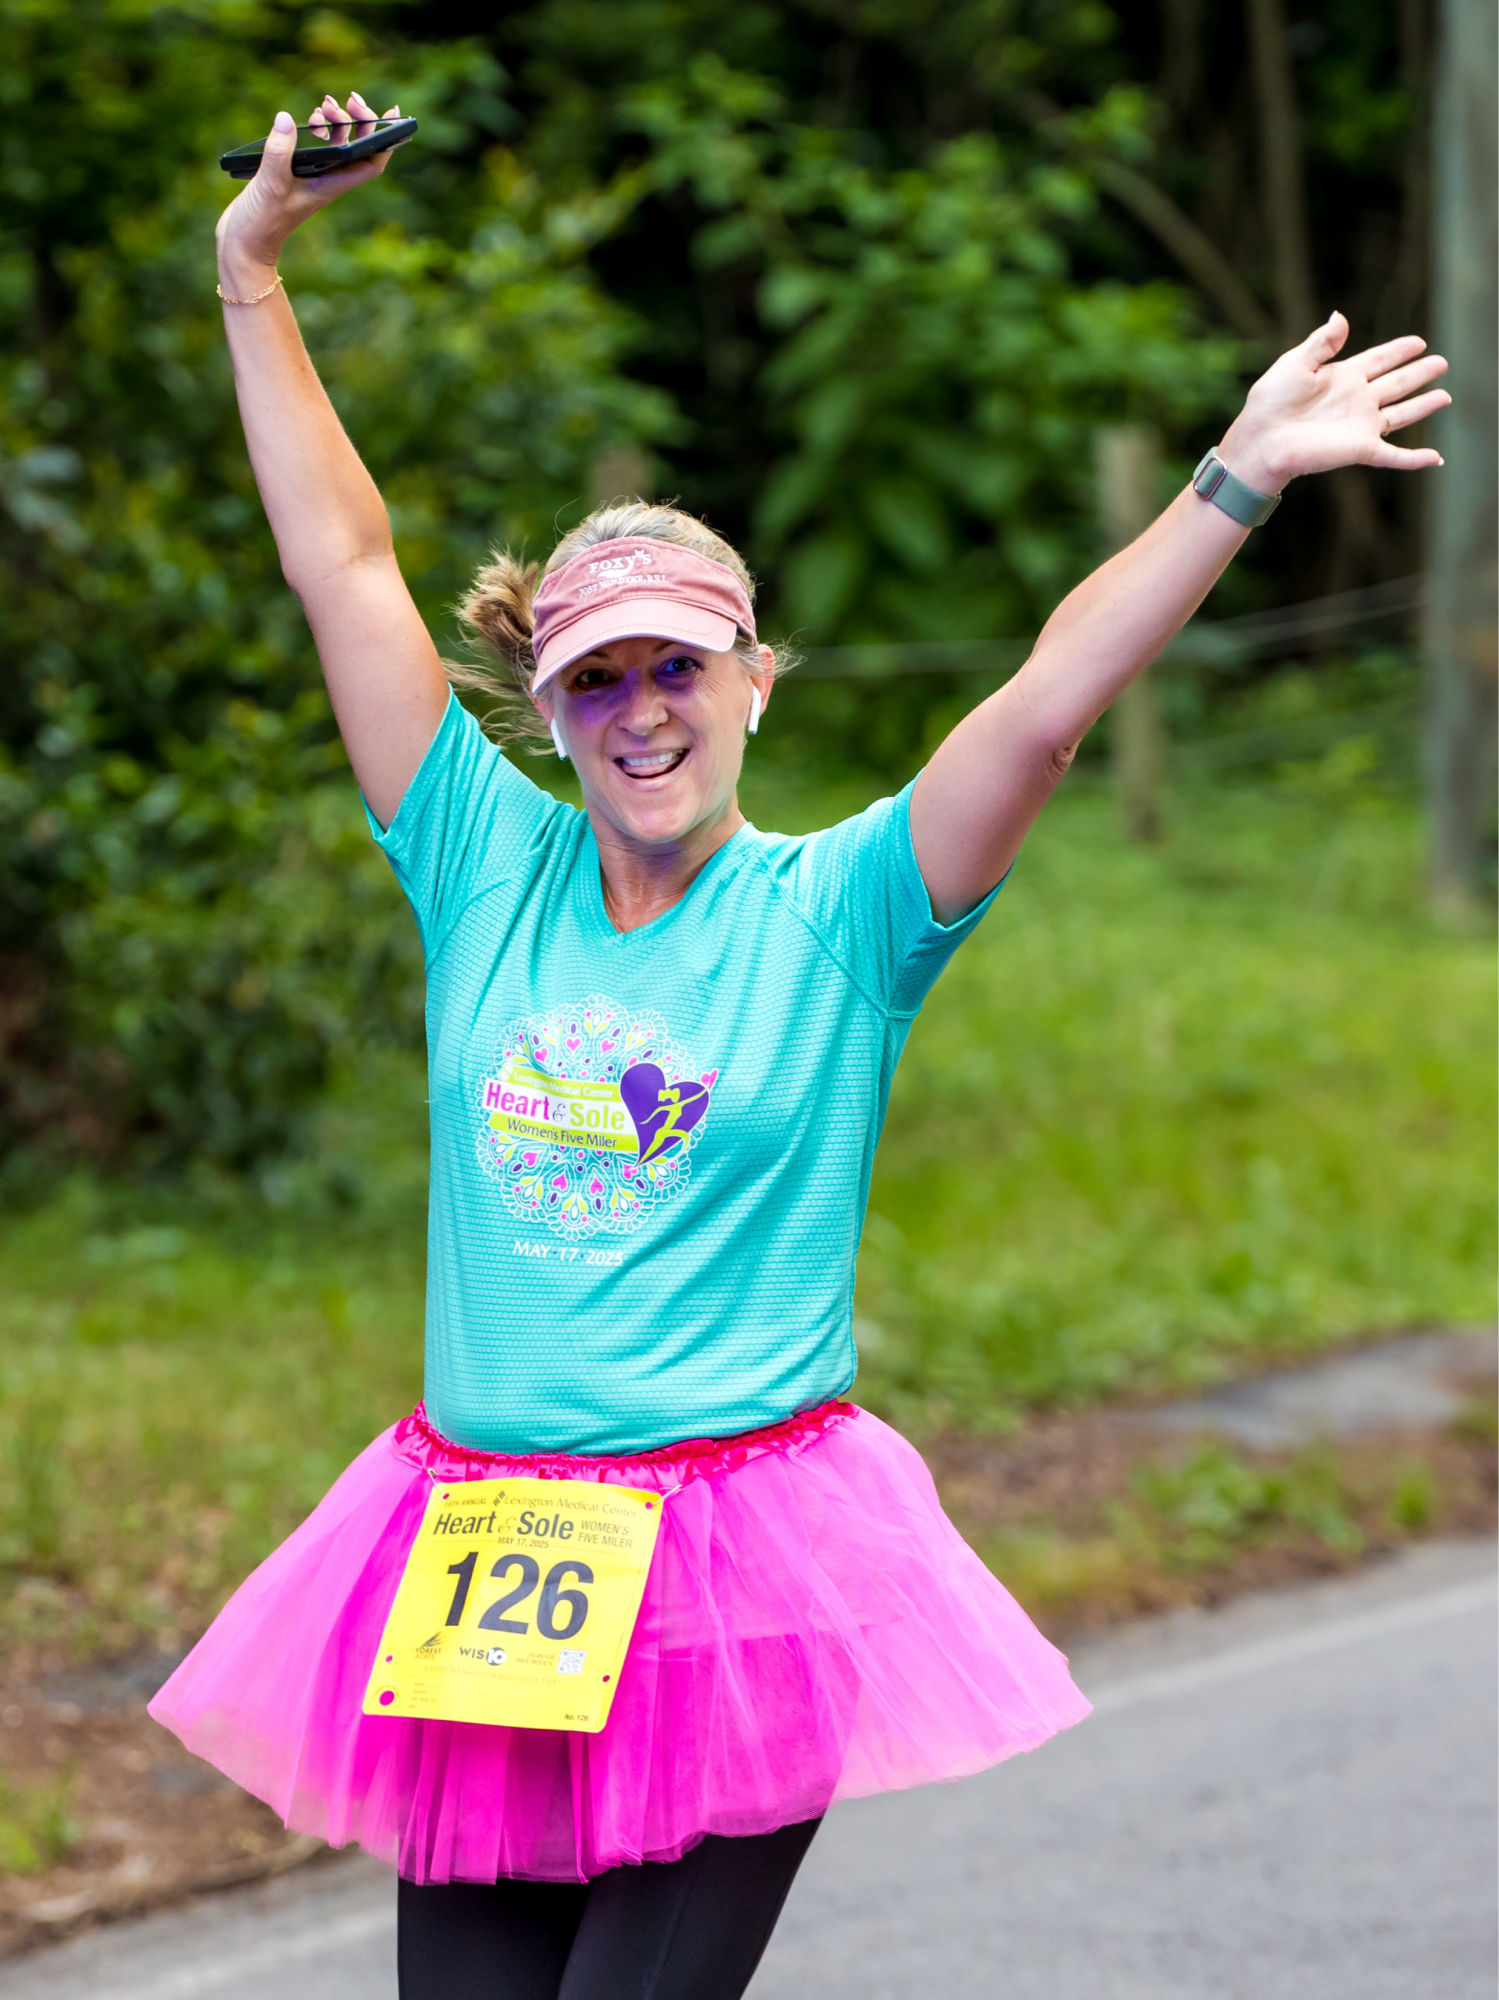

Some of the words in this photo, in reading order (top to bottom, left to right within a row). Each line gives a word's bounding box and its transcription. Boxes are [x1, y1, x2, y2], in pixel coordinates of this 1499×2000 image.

[579, 583, 599, 597] JOST
[599, 578, 618, 588] VAN
[582, 1086, 614, 1098] Center
[486, 1082, 550, 1121] Heart
[552, 1103, 567, 1122] &
[569, 1102, 625, 1131] Sole
[507, 1117, 559, 1141] Women's
[561, 1130, 584, 1145] Five
[586, 1133, 618, 1148] Miler
[512, 1240, 551, 1259] MAY
[560, 1247, 579, 1262] 17
[586, 1250, 624, 1267] 2025
[460, 1497, 487, 1506] ANNUAL
[504, 1495, 555, 1508] Lexington
[557, 1498, 599, 1512] Medical
[602, 1504, 638, 1519] Center
[432, 1511, 497, 1535] Heart
[498, 1517, 516, 1534] &
[517, 1510, 574, 1540] Sole
[581, 1519, 630, 1536] WOMEN'S
[498, 1537, 515, 1546] MAY
[516, 1538, 528, 1548] 17,
[530, 1539, 549, 1549] 2025
[578, 1532, 599, 1544] FIVE
[601, 1535, 633, 1549] MILER
[445, 1551, 594, 1640] 126
